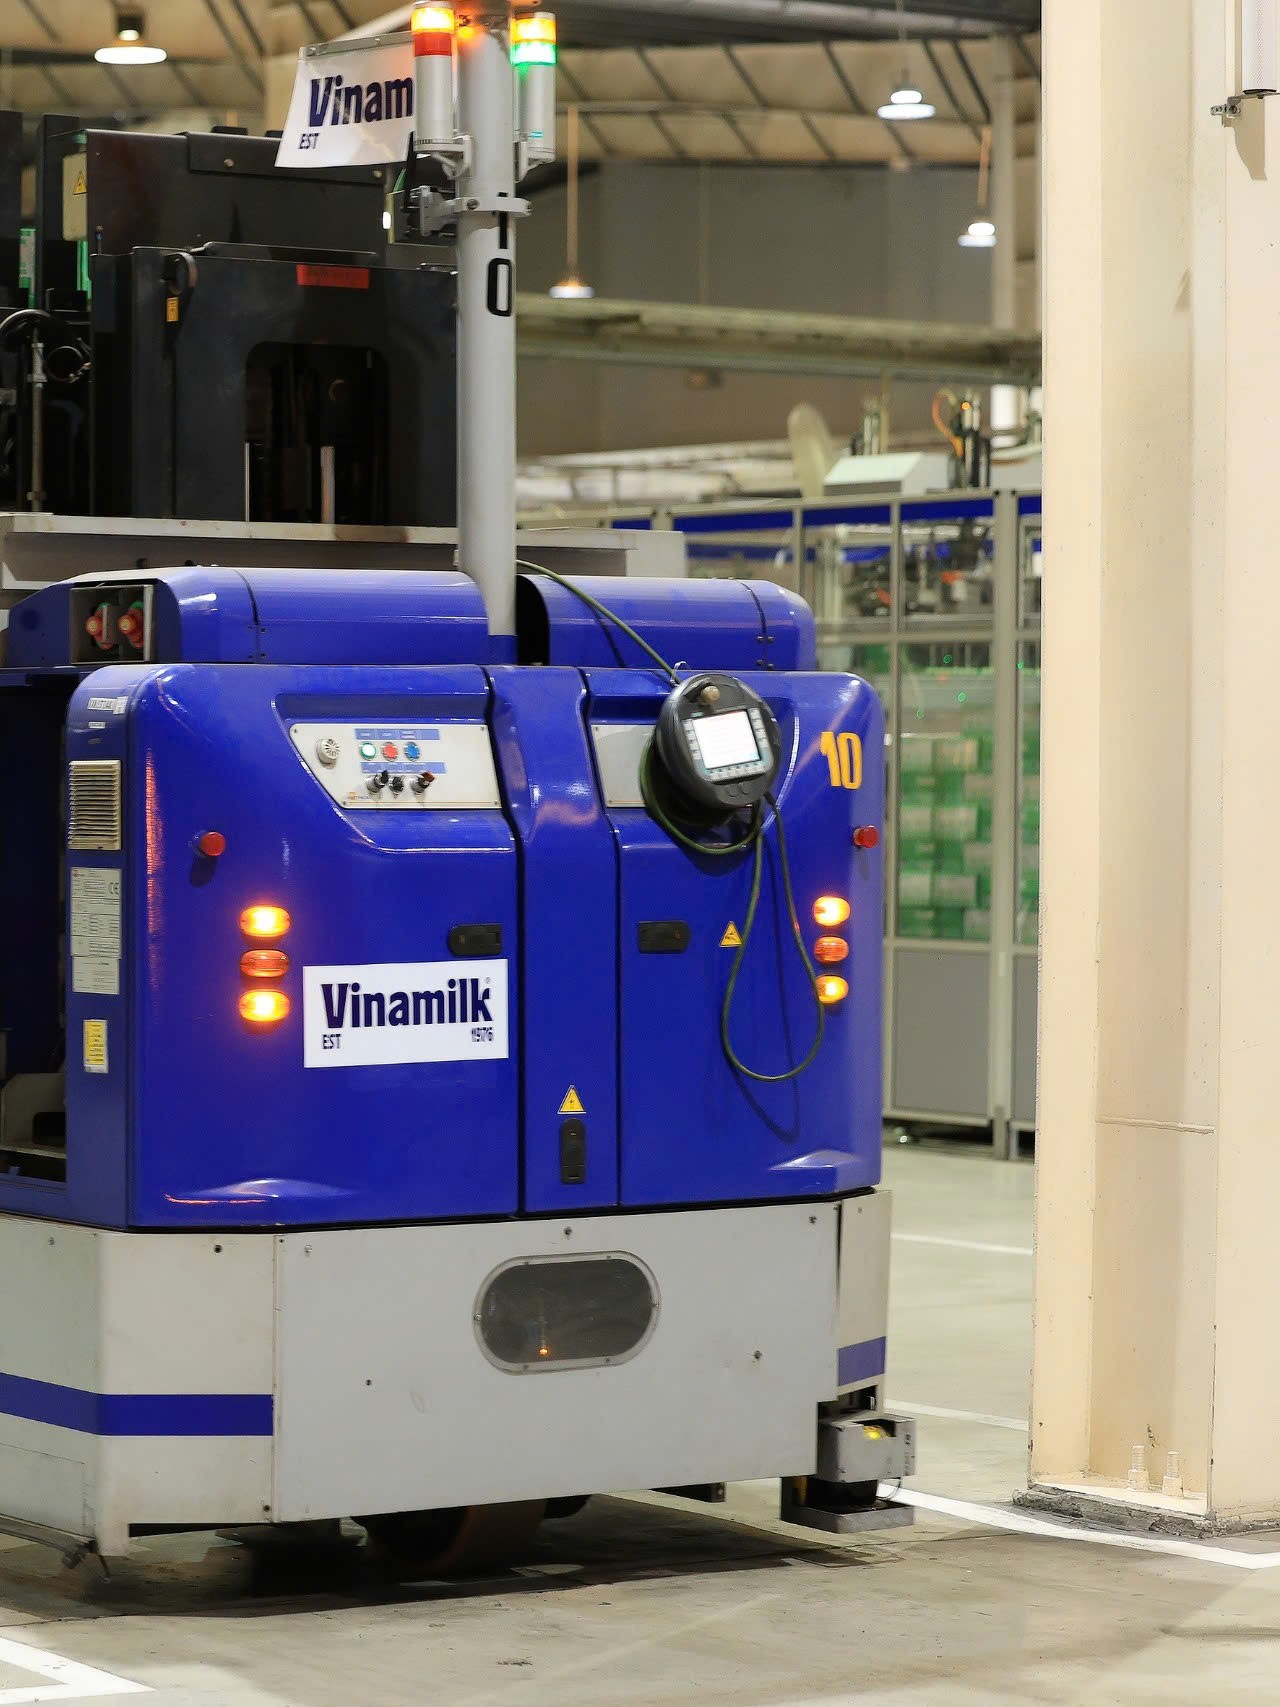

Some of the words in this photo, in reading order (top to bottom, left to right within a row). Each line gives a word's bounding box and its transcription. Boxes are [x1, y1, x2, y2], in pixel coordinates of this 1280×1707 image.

[309, 75, 414, 127] Vinam
[298, 133, 320, 150] EST
[820, 731, 863, 790] 10
[321, 978, 493, 1028] Vinamilk
[322, 1033, 341, 1049] EST
